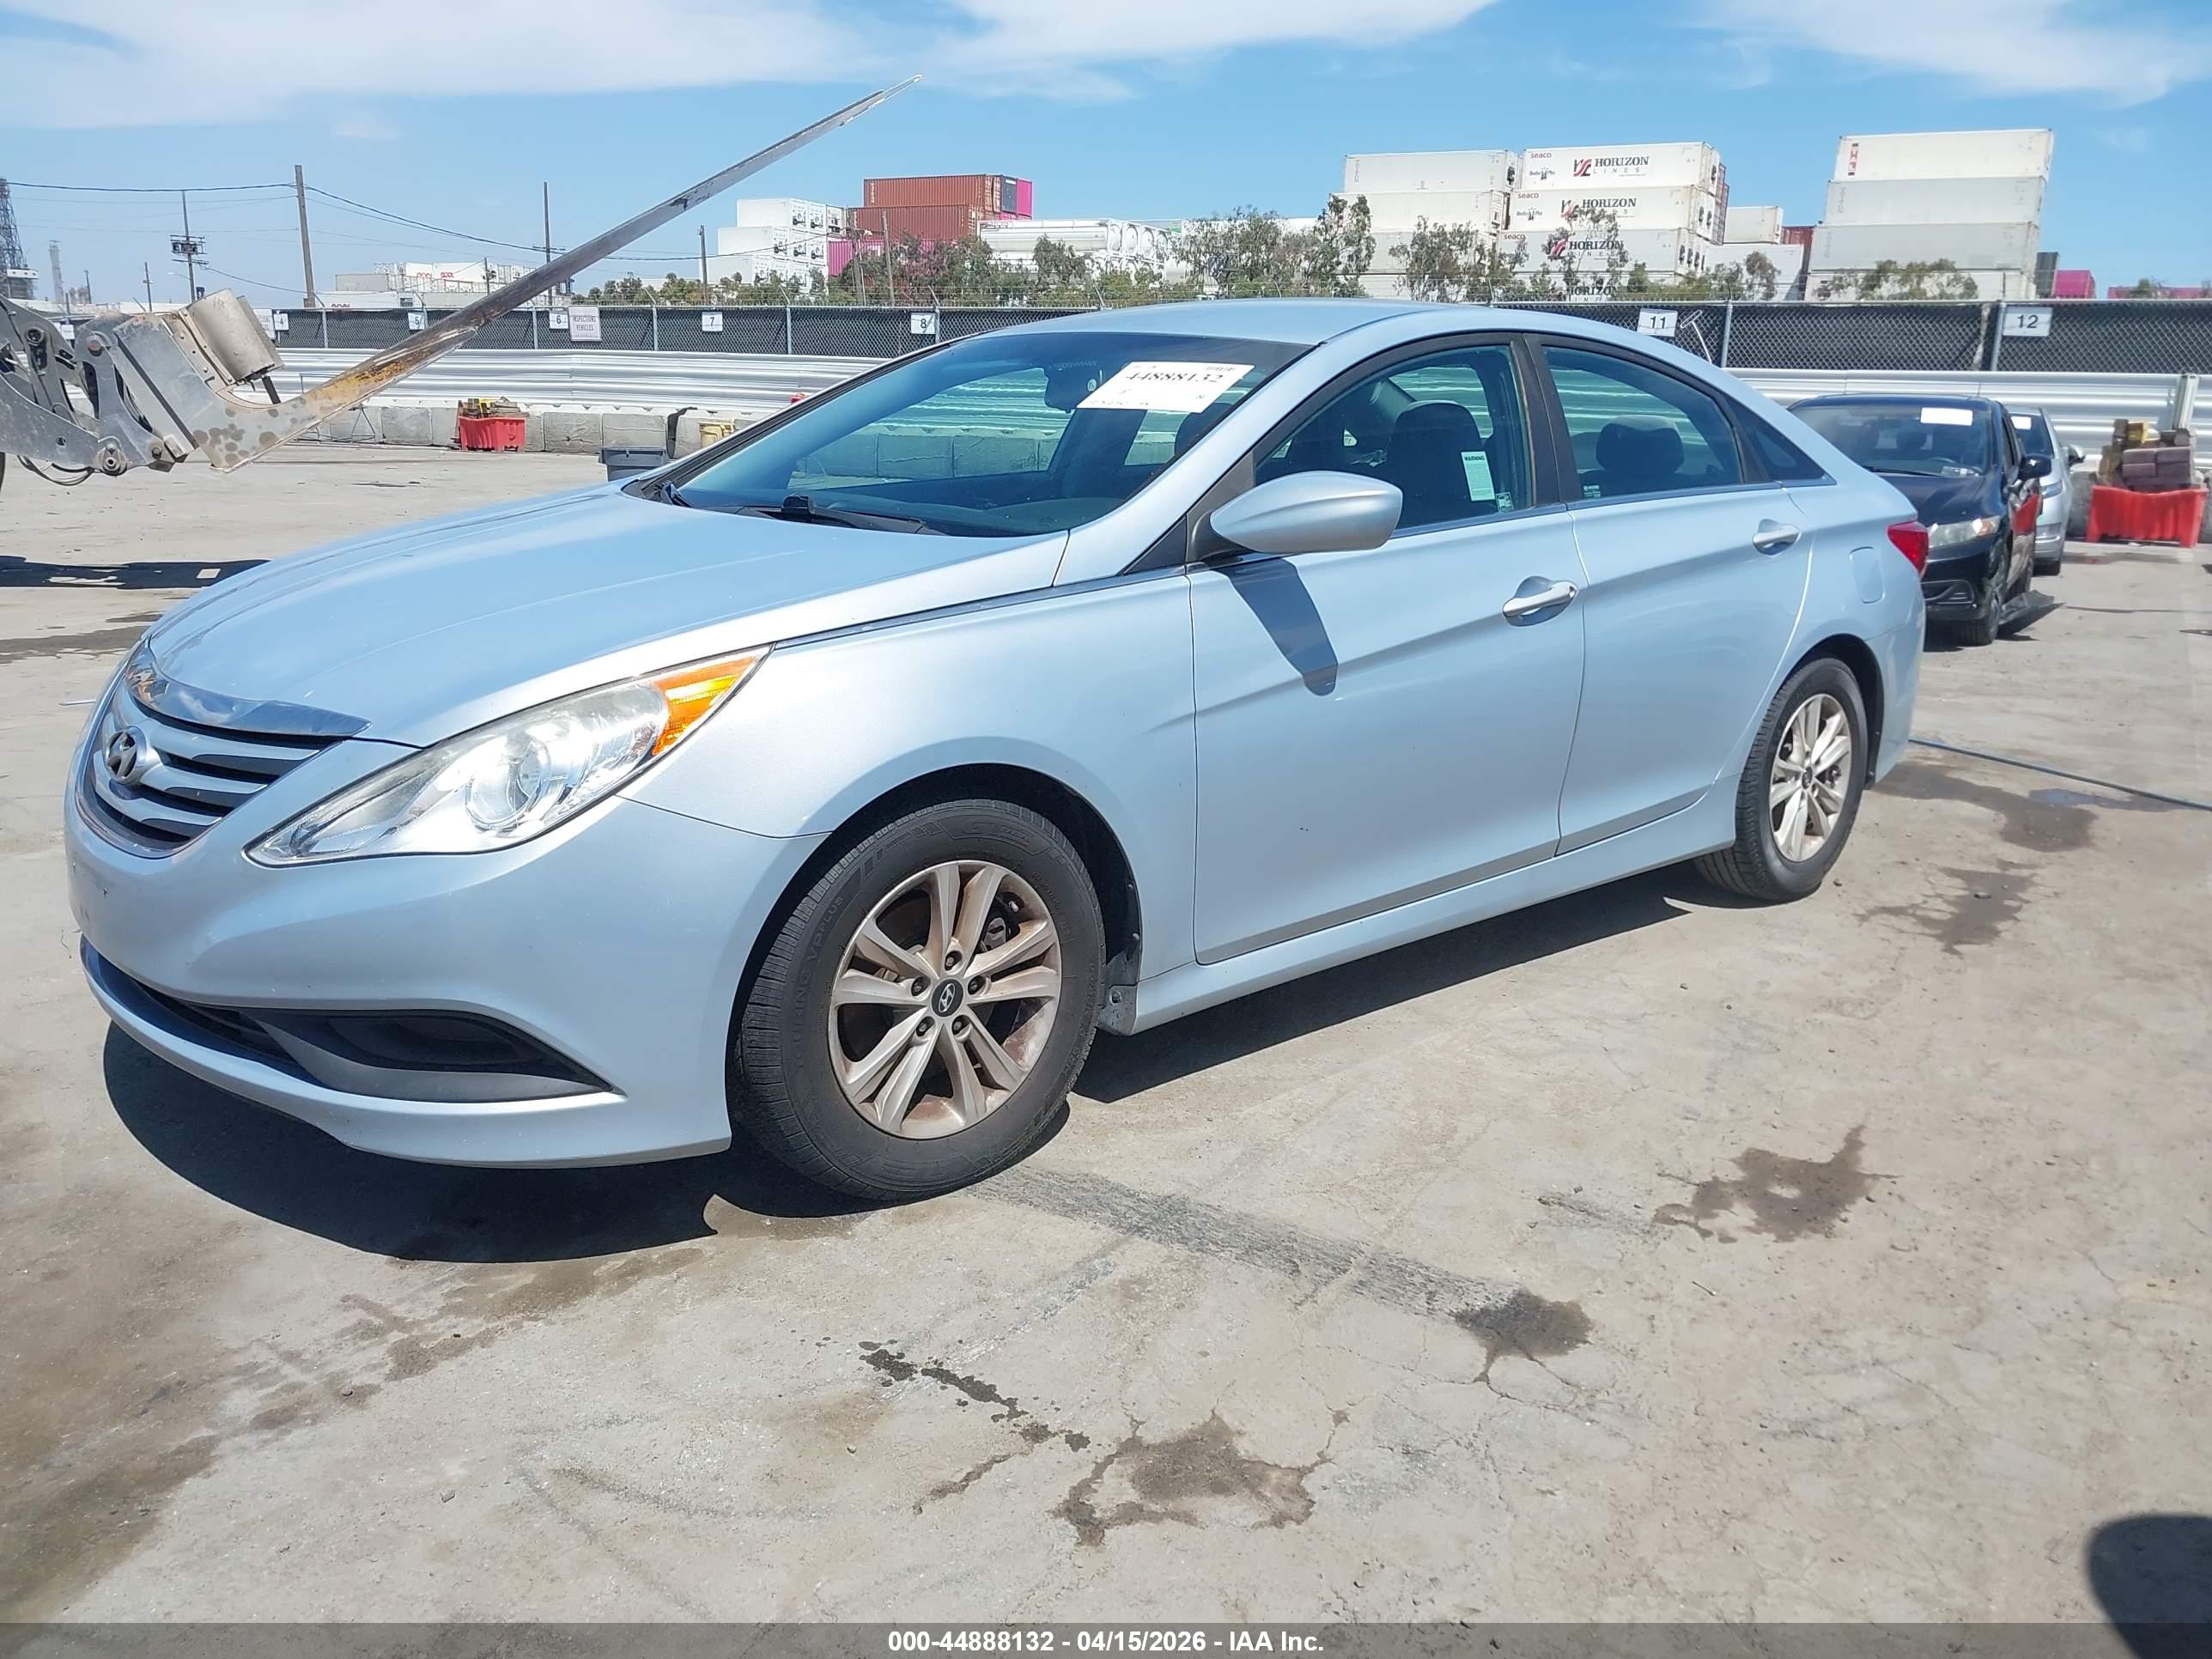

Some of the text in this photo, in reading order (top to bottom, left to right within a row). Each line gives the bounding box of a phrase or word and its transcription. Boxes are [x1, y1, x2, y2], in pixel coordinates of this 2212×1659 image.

[1594, 156, 1650, 167] HORIZON
[1582, 198, 1638, 208] HORIZON
[1568, 240, 1625, 250] HORIZON
[414, 315, 420, 325] 5
[556, 315, 562, 325] 6
[708, 317, 715, 326] 7
[921, 318, 927, 329] 8
[1650, 315, 1666, 329] 11
[2017, 314, 2039, 329] 12
